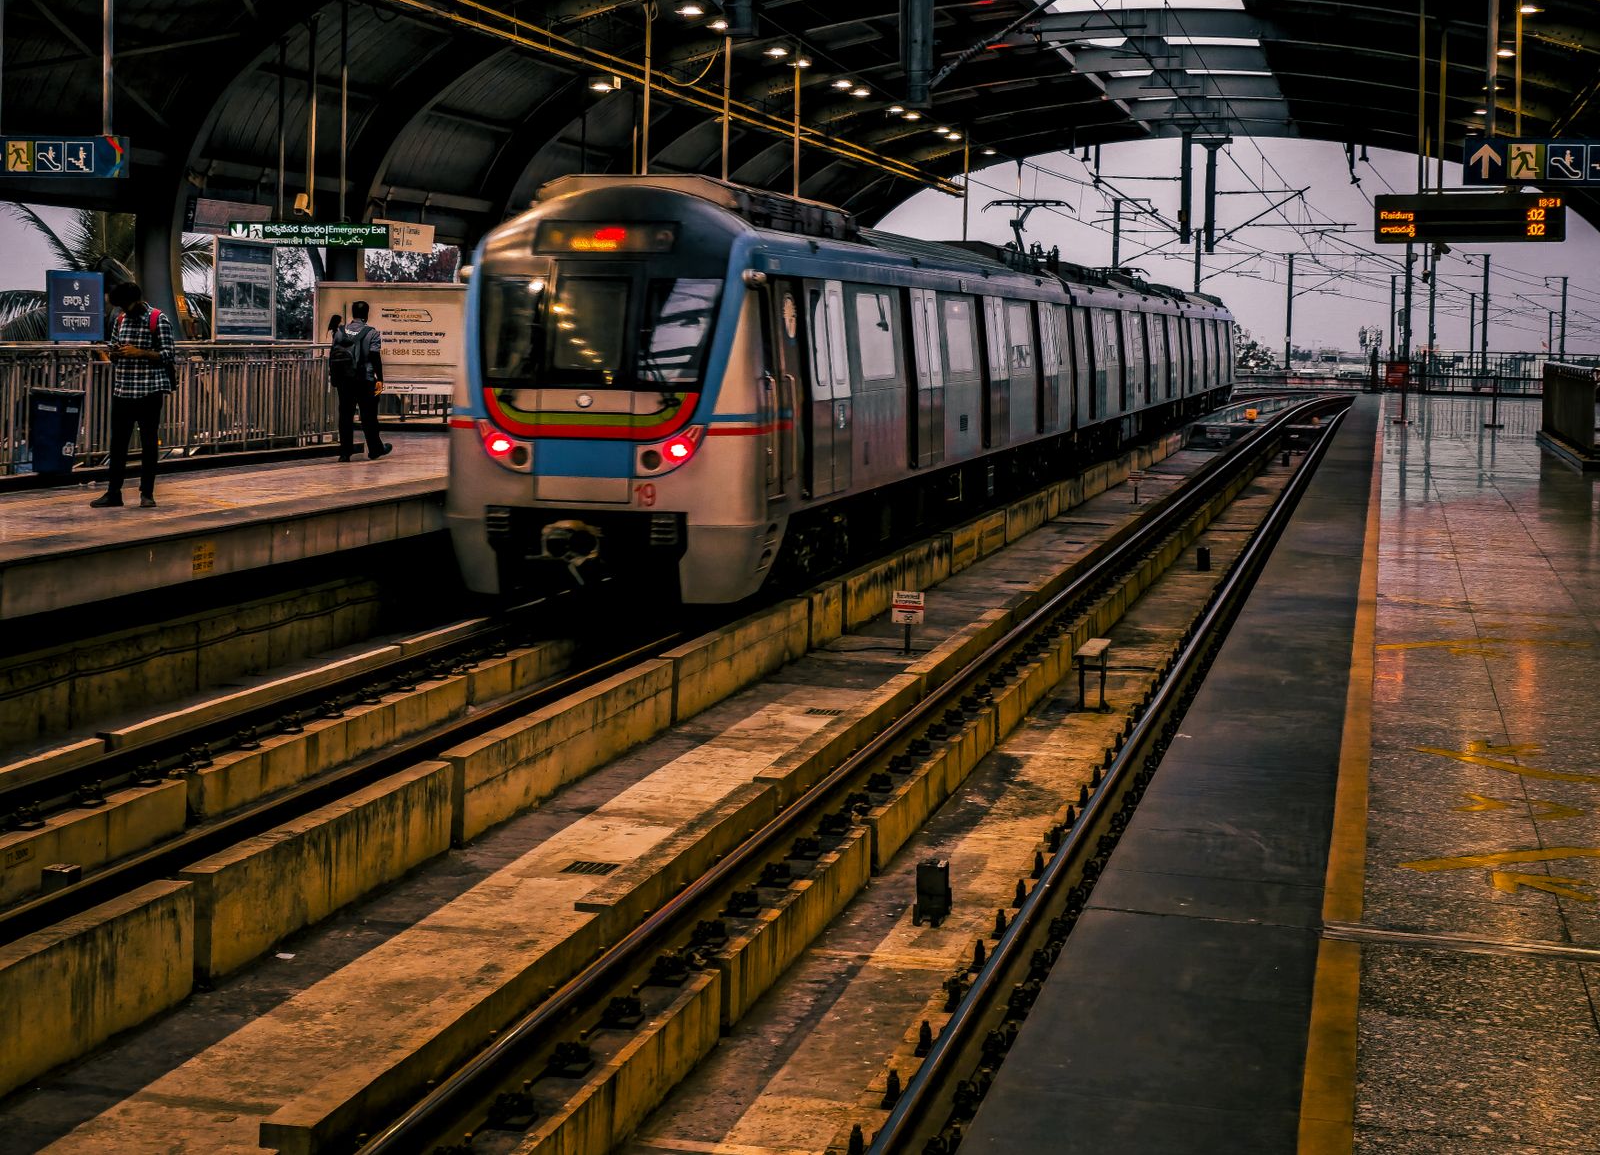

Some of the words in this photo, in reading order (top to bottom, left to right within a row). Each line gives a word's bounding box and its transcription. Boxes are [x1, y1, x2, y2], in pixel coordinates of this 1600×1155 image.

[1380, 211, 1414, 222] Raidurg
[328, 225, 371, 236] Emergency
[371, 225, 387, 234] Exit
[411, 348, 426, 356] 555
[426, 348, 441, 356] 555
[634, 483, 656, 508] 19
